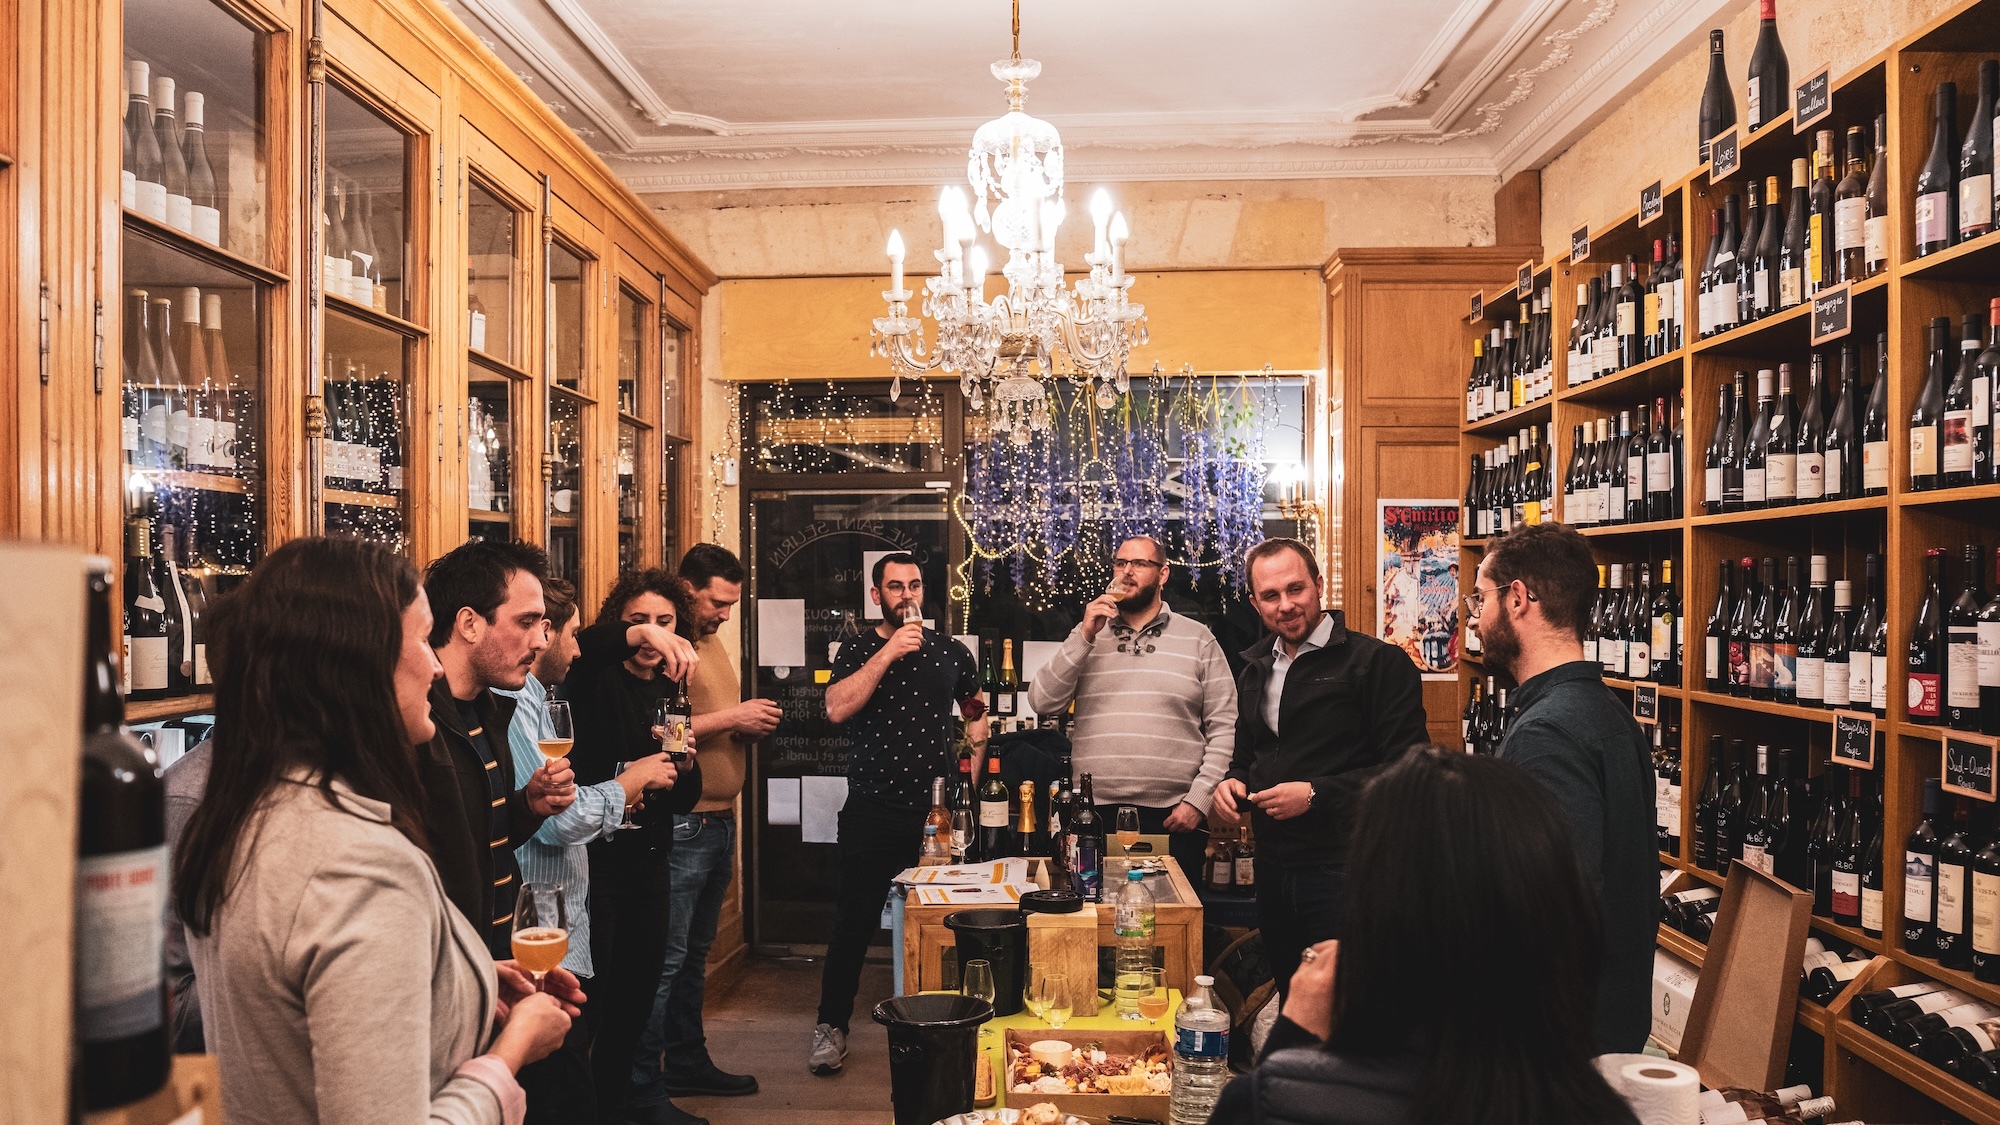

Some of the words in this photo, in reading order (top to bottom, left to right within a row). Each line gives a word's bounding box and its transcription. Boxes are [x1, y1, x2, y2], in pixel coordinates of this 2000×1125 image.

[1815, 296, 1845, 316] Bourgogne
[1821, 321, 1835, 334] Rouge
[1401, 507, 1459, 526] Emilio
[1921, 679, 1937, 687] COMME
[1925, 698, 1937, 706] CAVE
[1838, 715, 1869, 740] Beaujolais
[1947, 747, 1992, 778] Sud-Ouest
